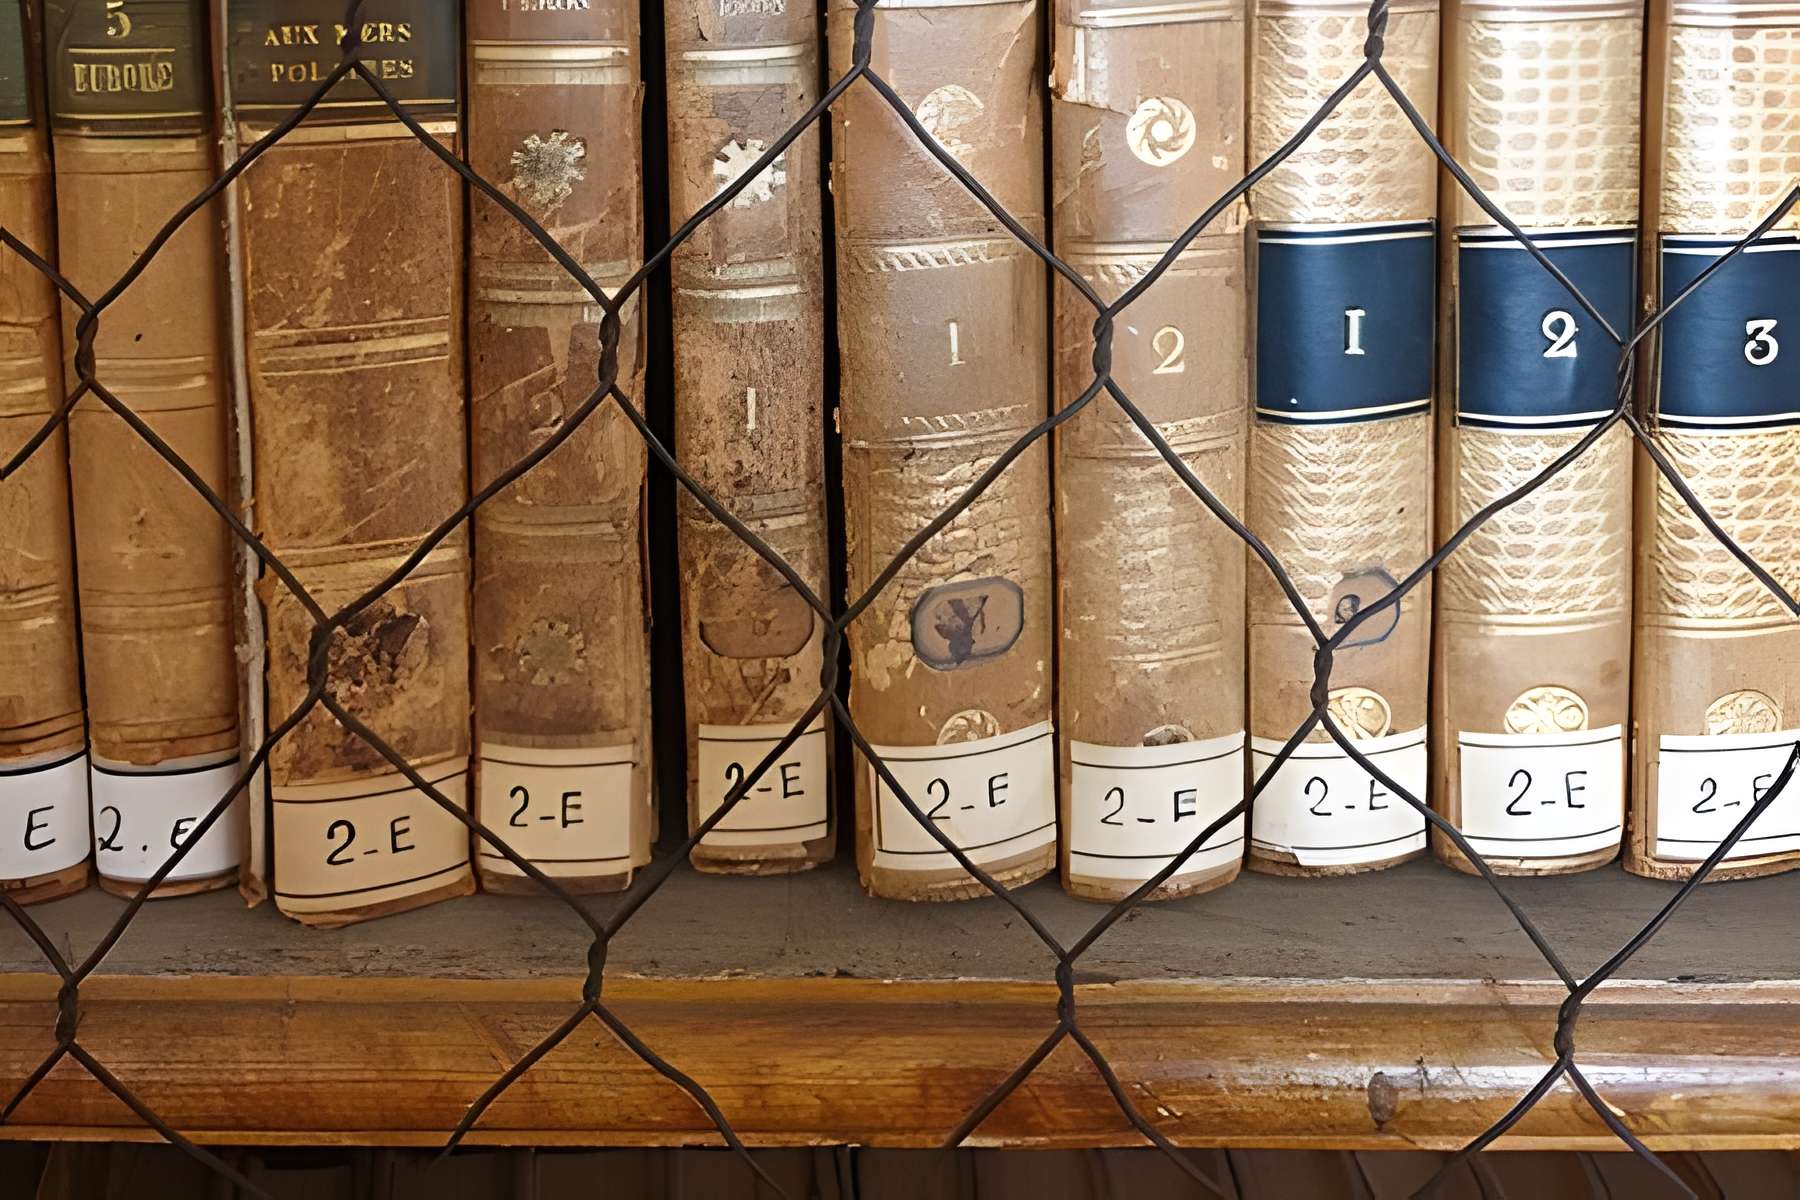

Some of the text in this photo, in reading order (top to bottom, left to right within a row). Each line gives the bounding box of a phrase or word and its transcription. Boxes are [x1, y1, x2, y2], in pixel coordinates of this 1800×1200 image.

[104, 0, 133, 40] 5
[1151, 326, 1186, 374] 2
[1541, 309, 1579, 359] 2
[1744, 318, 1780, 366] 3
[509, 785, 585, 829] 2-E
[925, 771, 1010, 821] 2-E
[1506, 768, 1588, 817] 2-E
[325, 815, 417, 866] 2-E
